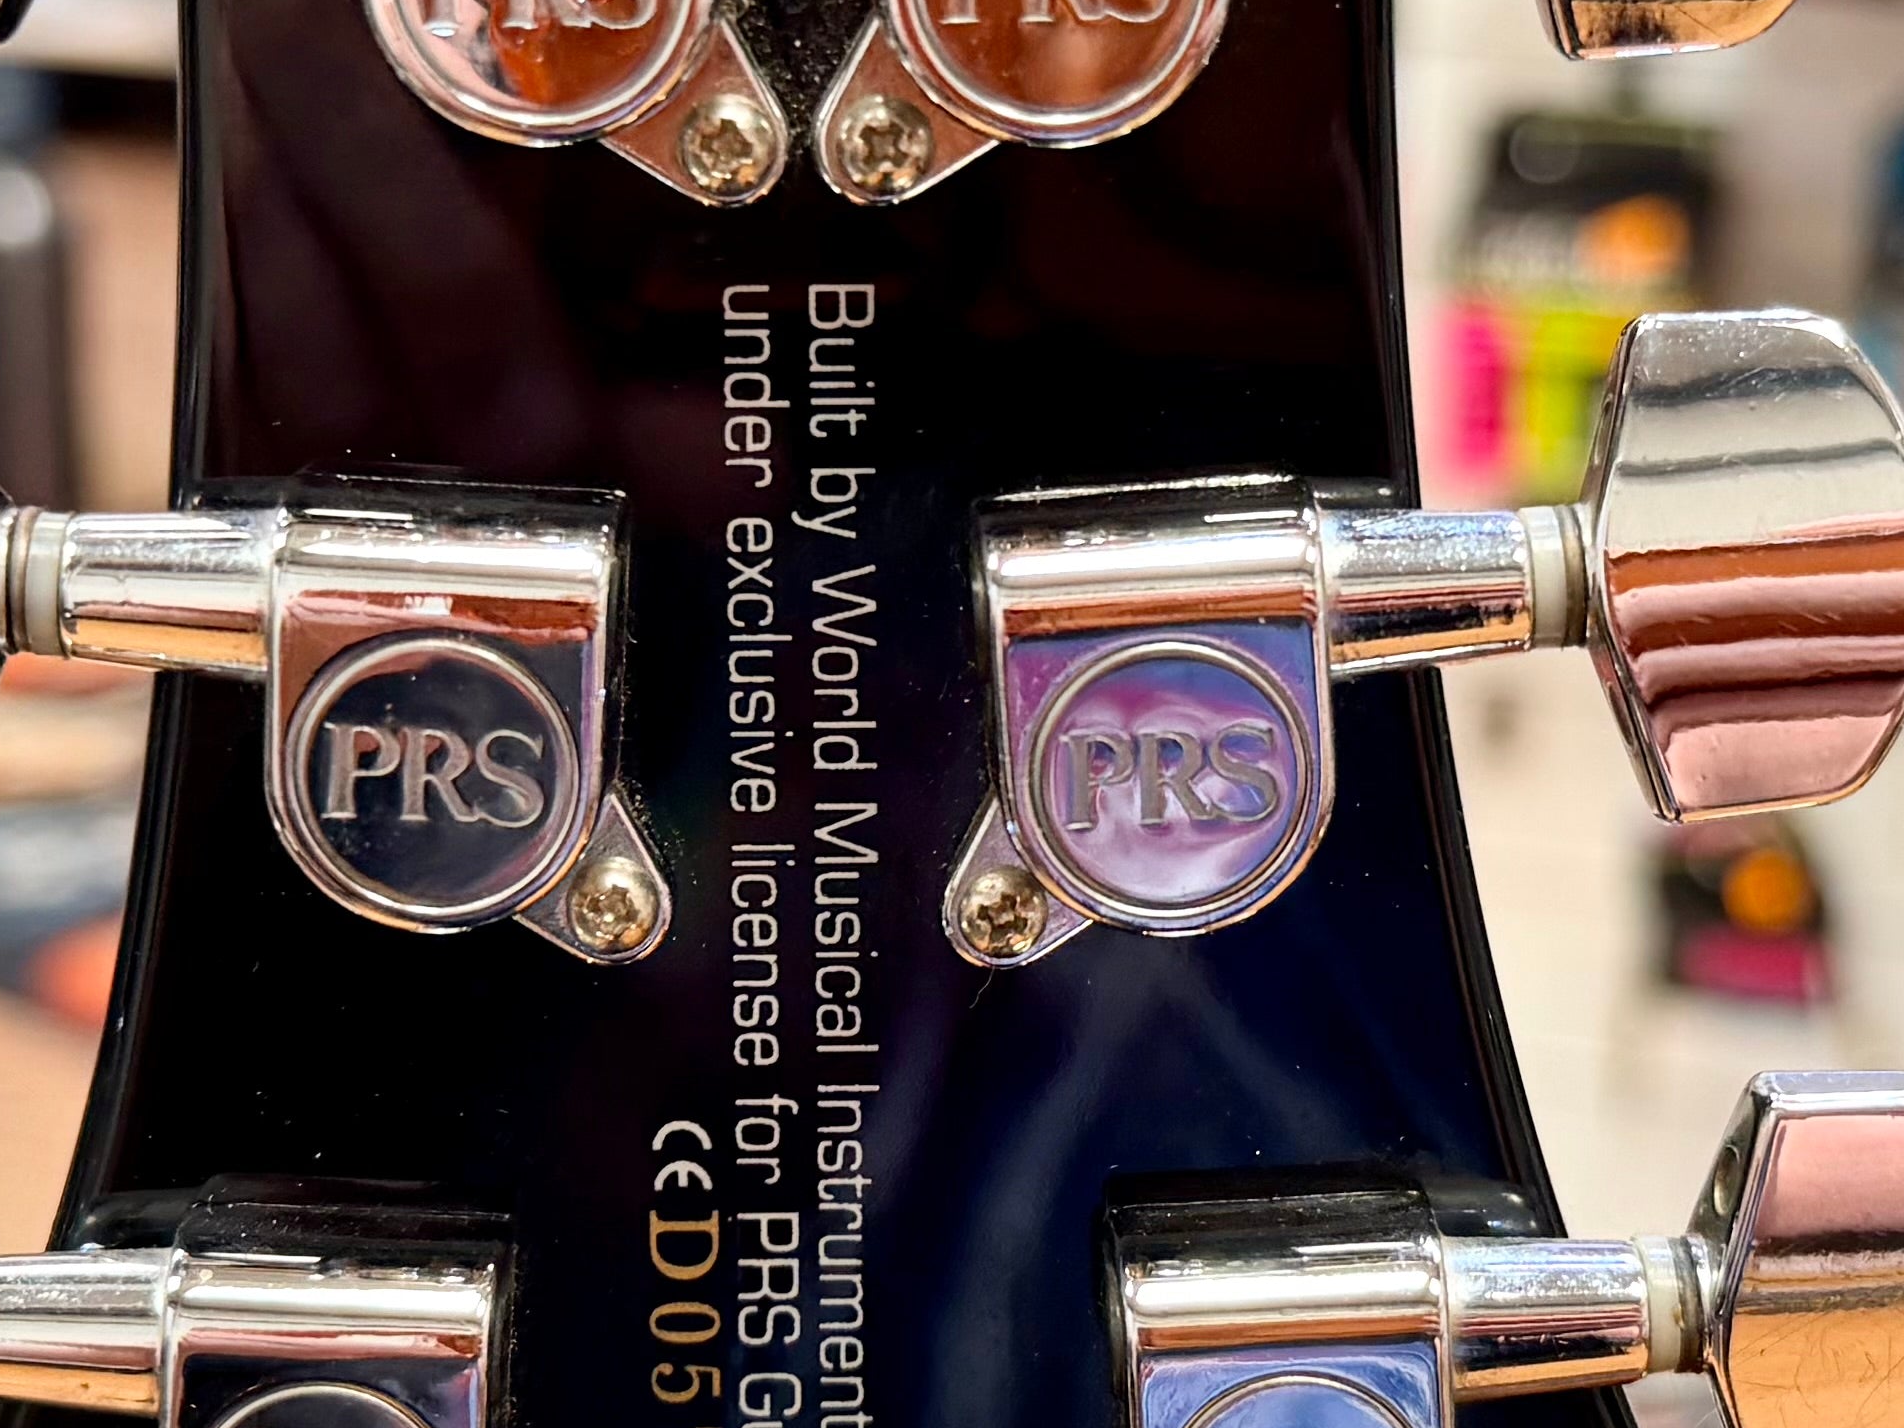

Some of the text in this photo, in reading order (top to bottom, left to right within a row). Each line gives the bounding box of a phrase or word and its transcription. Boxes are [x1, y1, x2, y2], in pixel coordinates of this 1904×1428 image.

[722, 284, 791, 489] under
[807, 283, 876, 439] Built
[791, 466, 877, 540] by
[726, 510, 795, 814] exclusive
[812, 563, 879, 771] World
[321, 722, 544, 828] PRS
[1059, 720, 1279, 830] PRS
[730, 843, 797, 1067] license
[813, 801, 880, 1053] Musical
[734, 1092, 800, 1185] for
[736, 1209, 802, 1346] PRS
